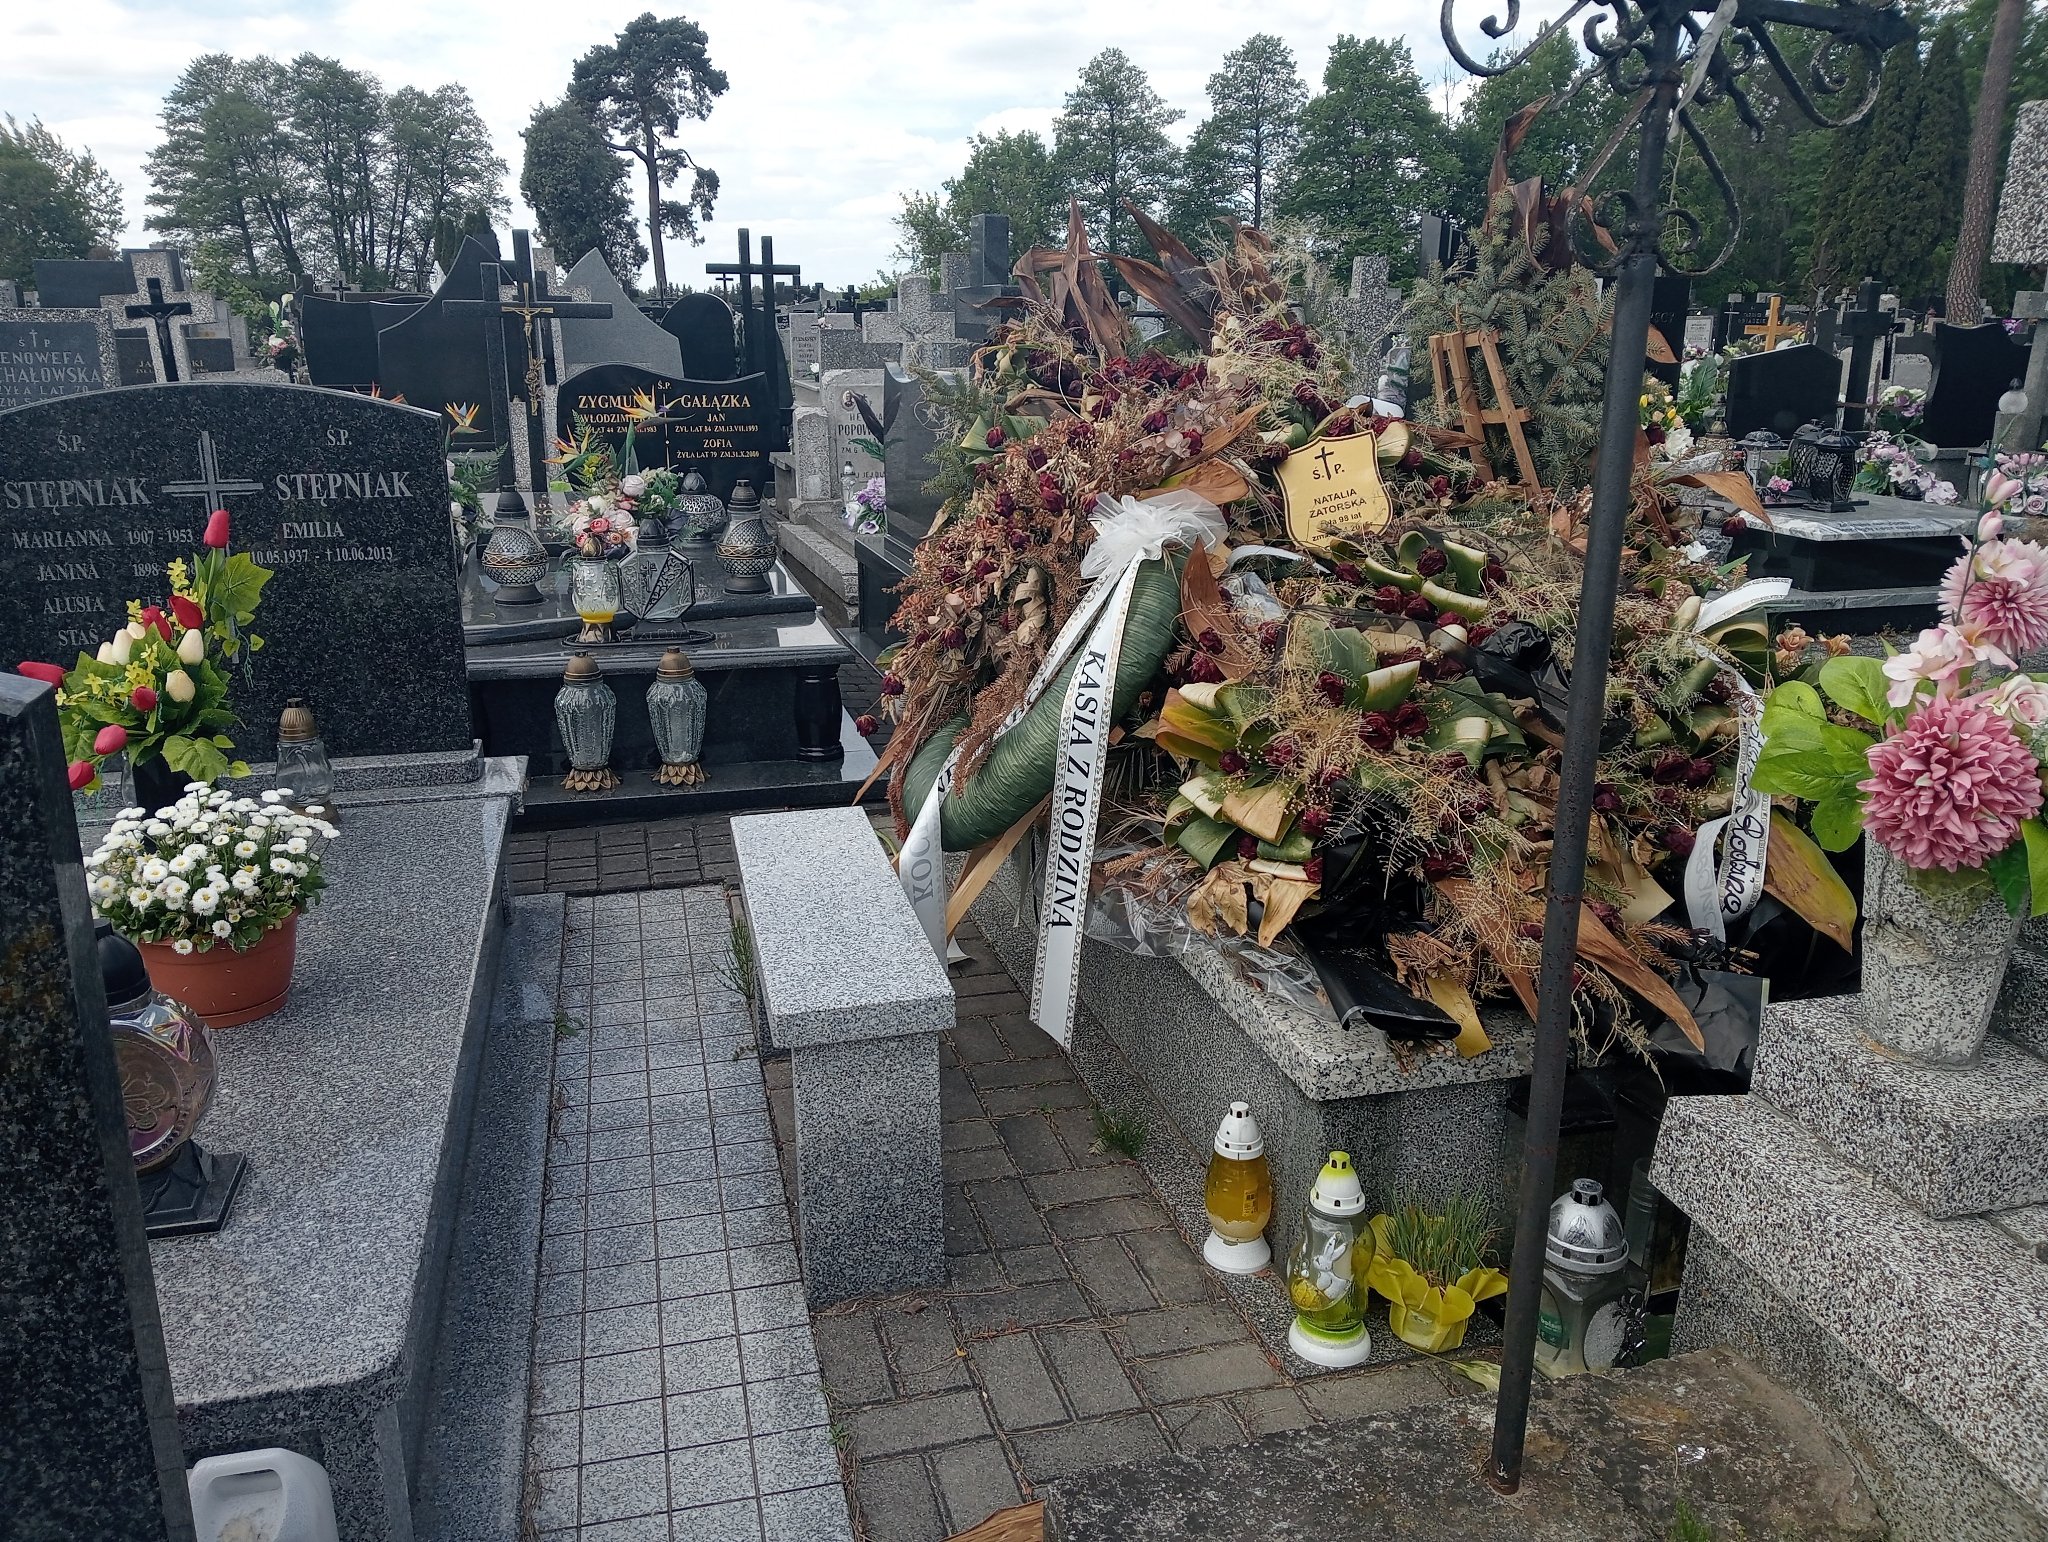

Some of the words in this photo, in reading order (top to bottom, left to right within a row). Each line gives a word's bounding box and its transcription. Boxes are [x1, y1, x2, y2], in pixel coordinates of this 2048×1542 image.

[0, 366, 102, 384] HAŁOWSKA
[40, 385, 65, 395] LAT
[681, 394, 751, 412] GAŁĄZKA
[707, 413, 726, 423] JAN
[690, 425, 703, 433] LAT
[703, 439, 733, 448] ZOFIA
[696, 451, 711, 459] LAT
[3, 477, 152, 516] STĘPNIAK
[275, 471, 414, 507] STĘPNIAK
[1313, 488, 1357, 505] NATALIA
[1309, 497, 1367, 518] ZATORSKA
[1351, 512, 1362, 520] lat
[12, 529, 114, 549] MARIANNA
[128, 529, 155, 545] 1907
[166, 528, 194, 544] 1953
[282, 521, 344, 539] EMILIA
[37, 562, 101, 582] JANINA
[132, 562, 160, 577] 1898
[44, 596, 105, 615] ALUSIA
[58, 623, 100, 647] STAŚ
[1070, 649, 1107, 748] KASIA
[1066, 755, 1090, 780] Z
